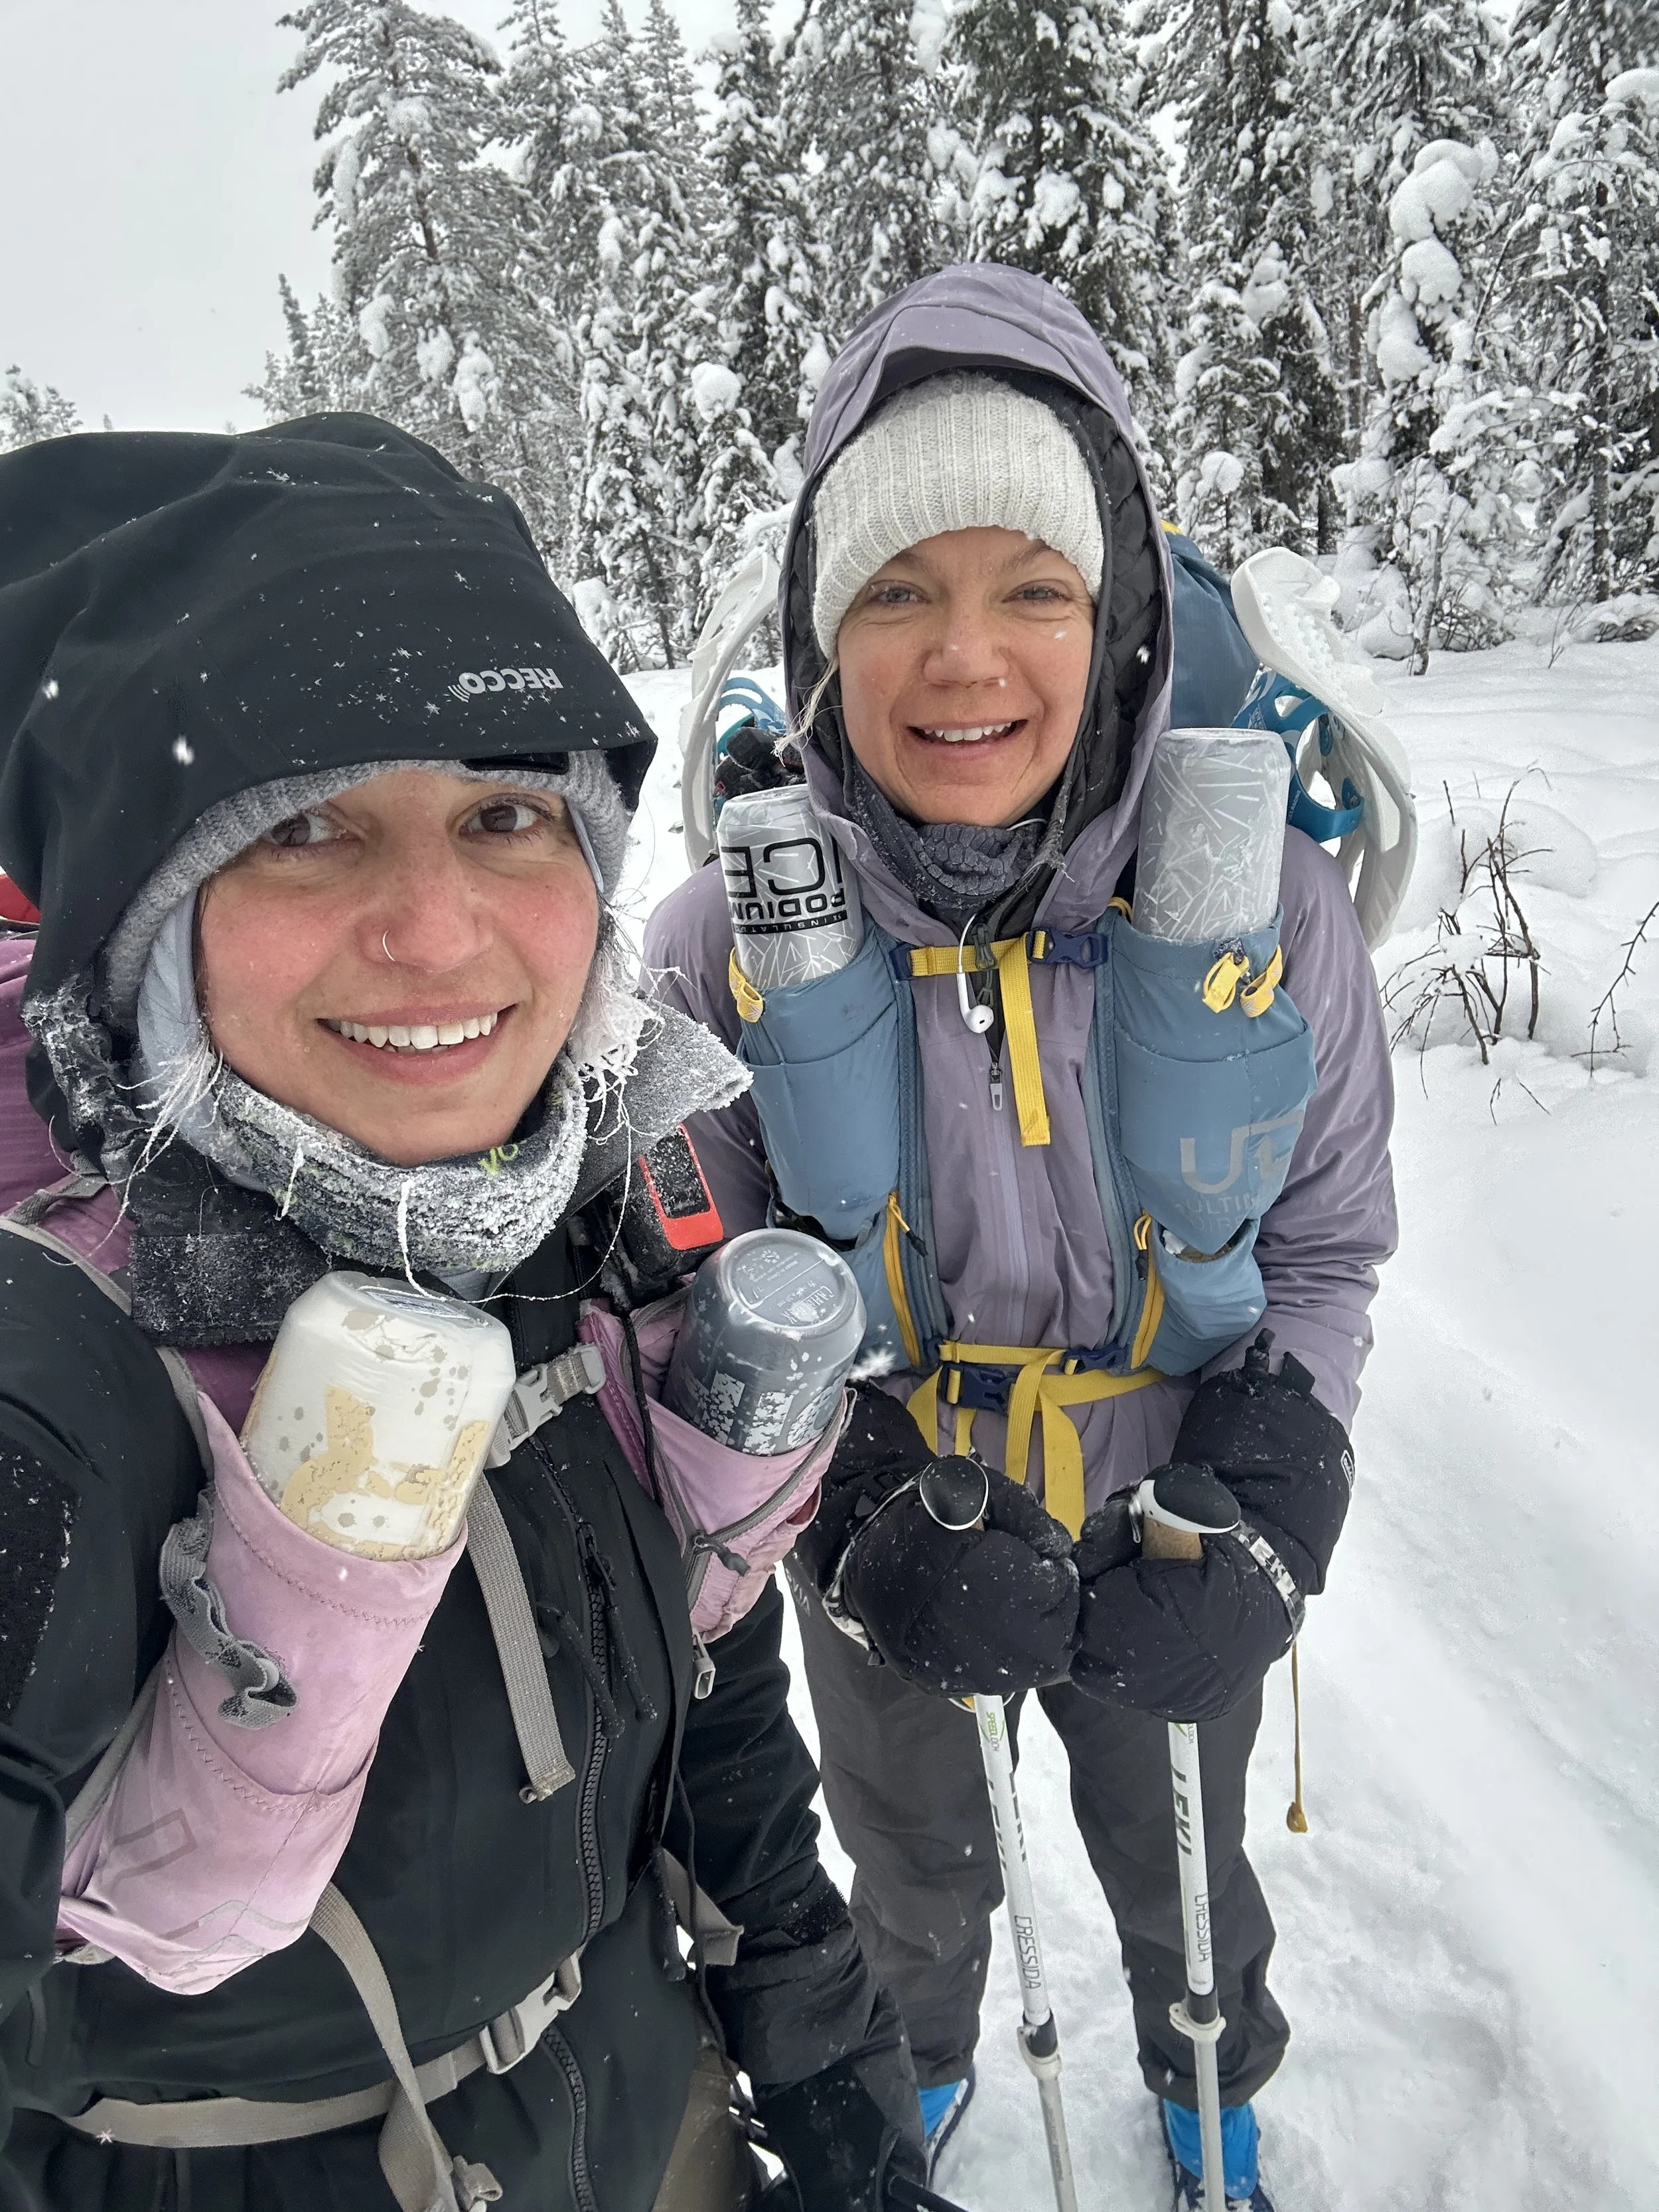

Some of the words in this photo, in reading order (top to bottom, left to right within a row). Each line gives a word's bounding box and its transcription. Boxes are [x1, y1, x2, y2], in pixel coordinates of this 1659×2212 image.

[459, 668, 563, 694] RECCO
[721, 836, 843, 898] ICE
[1015, 1915, 1041, 1990] CRESSIDA
